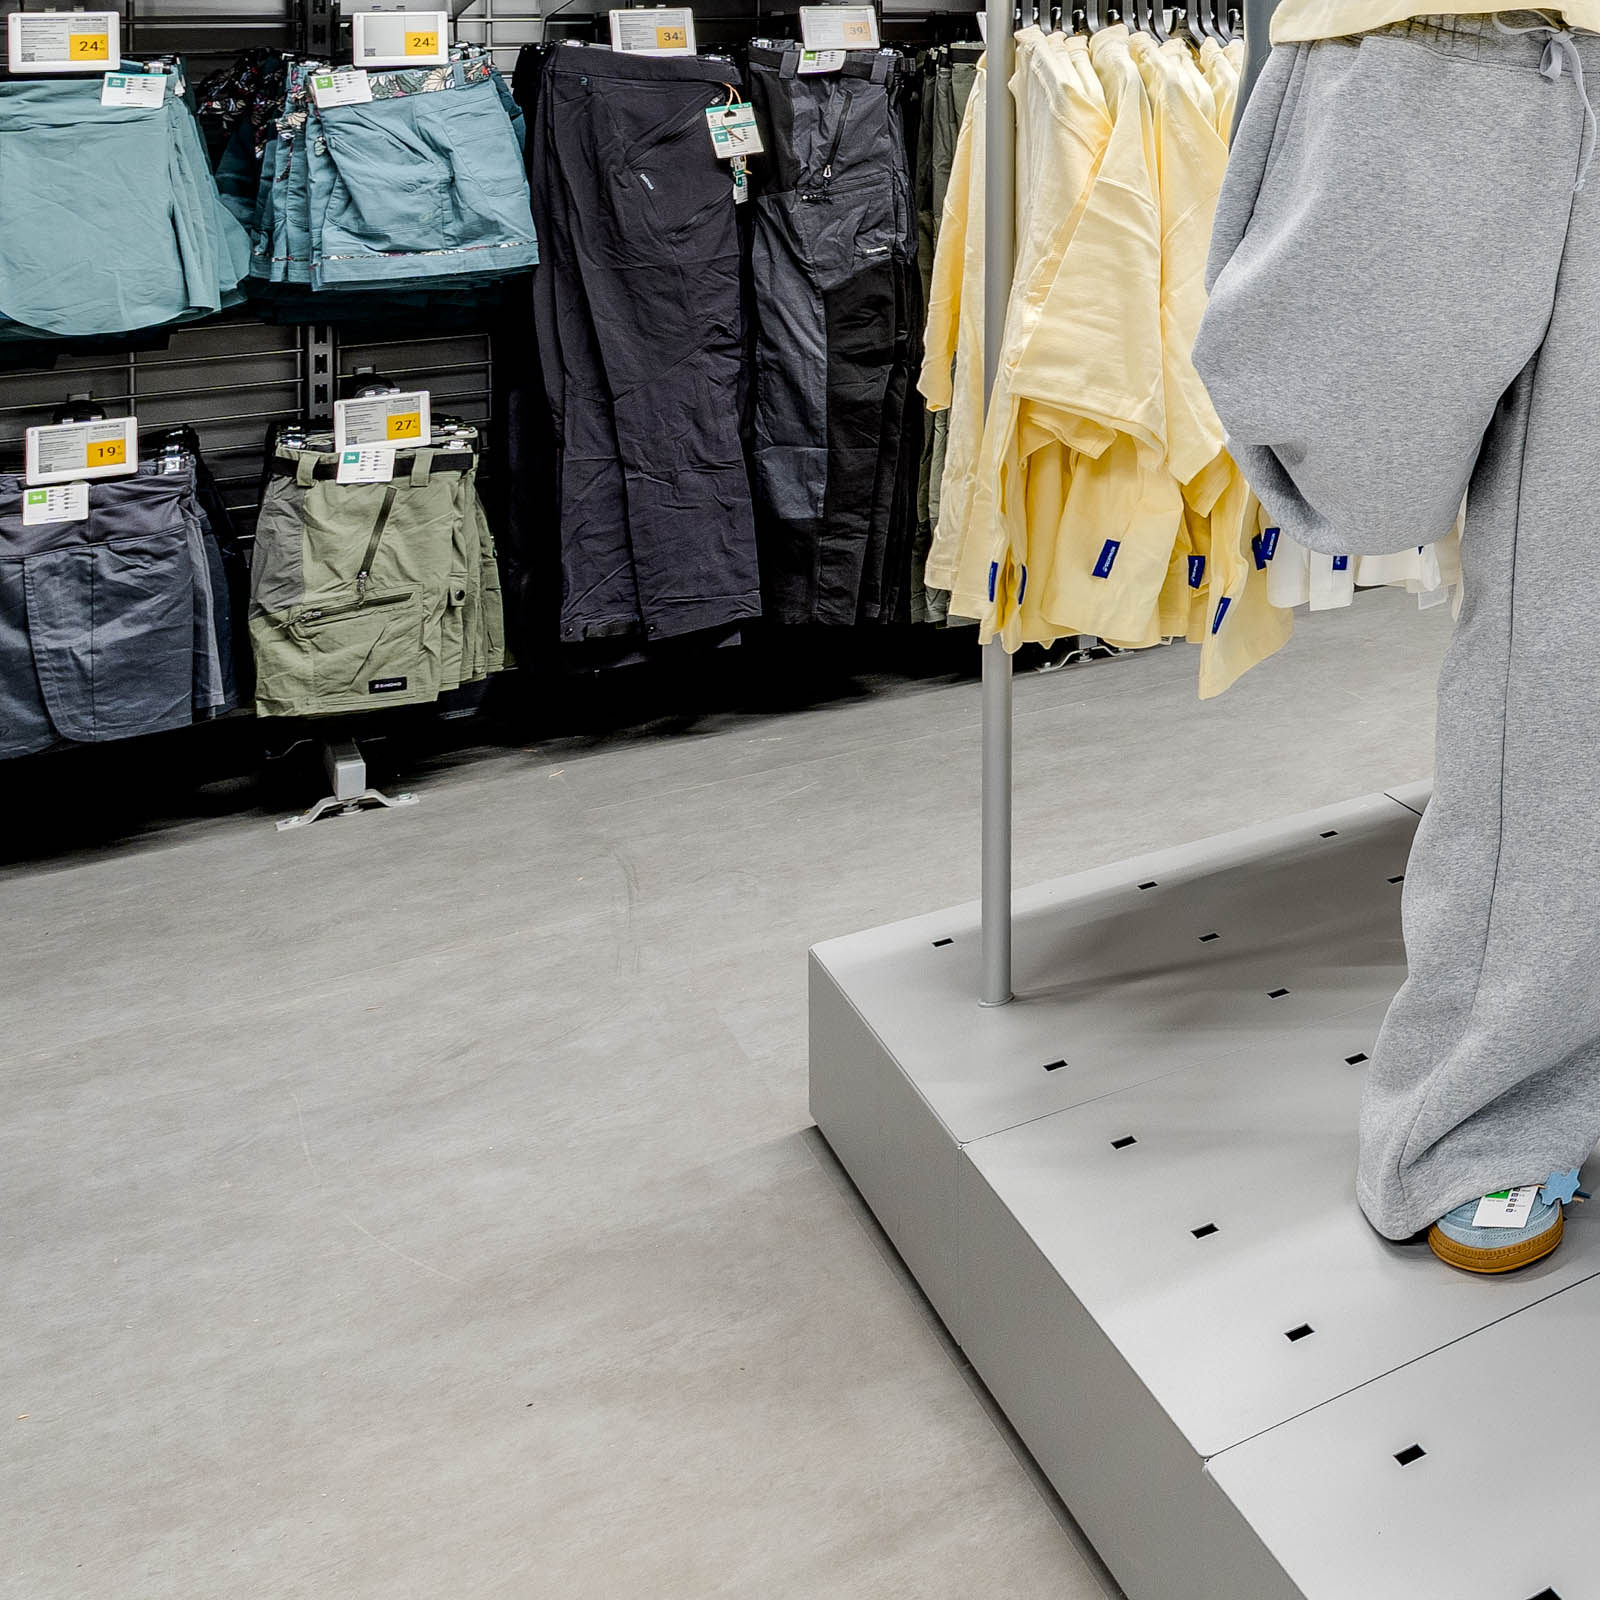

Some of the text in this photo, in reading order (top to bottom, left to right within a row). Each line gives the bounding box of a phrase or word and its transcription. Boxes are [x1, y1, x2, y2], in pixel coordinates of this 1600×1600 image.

[79, 40, 99, 52] 24
[412, 37, 430, 48] 24
[394, 419, 412, 431] 27
[97, 446, 116, 458] 19
